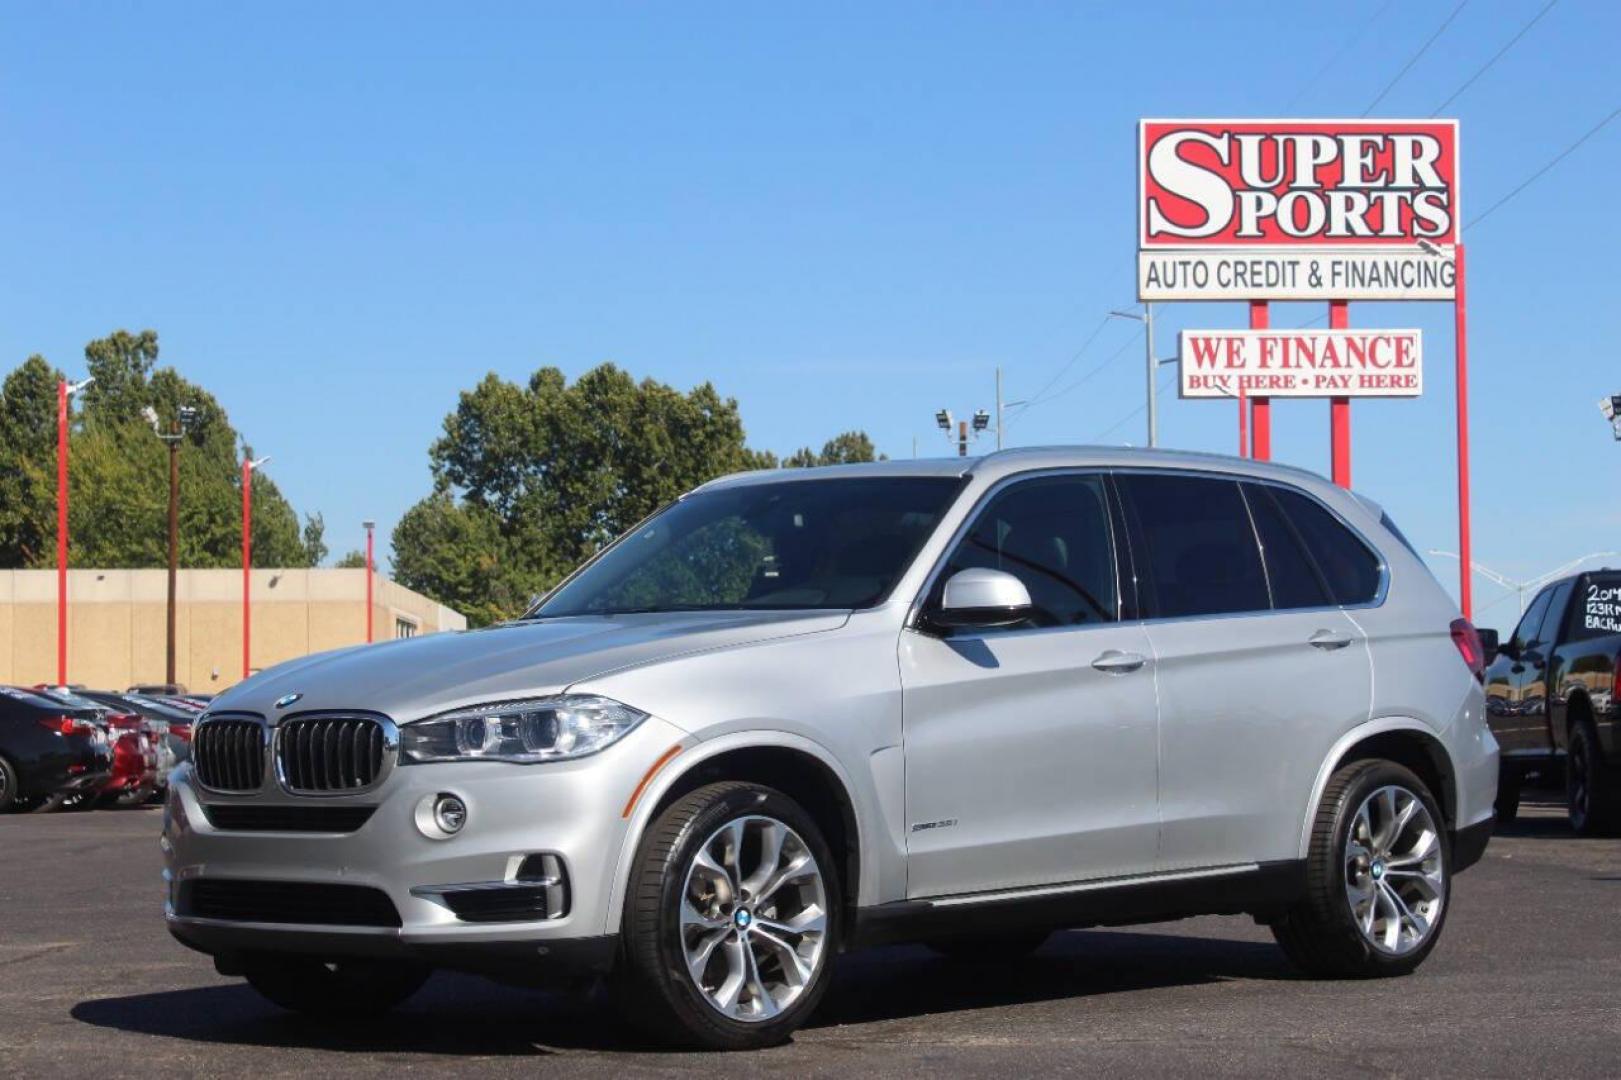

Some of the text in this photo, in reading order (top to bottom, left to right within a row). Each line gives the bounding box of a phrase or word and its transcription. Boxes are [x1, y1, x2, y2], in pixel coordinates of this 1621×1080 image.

[1149, 129, 1448, 239] SUPER
[1145, 260, 1456, 288] AUTO CREDIT & FINANCING
[1189, 336, 1416, 369] WE FINANCE
[1188, 375, 1418, 389] BUY HERE PAY HERE
